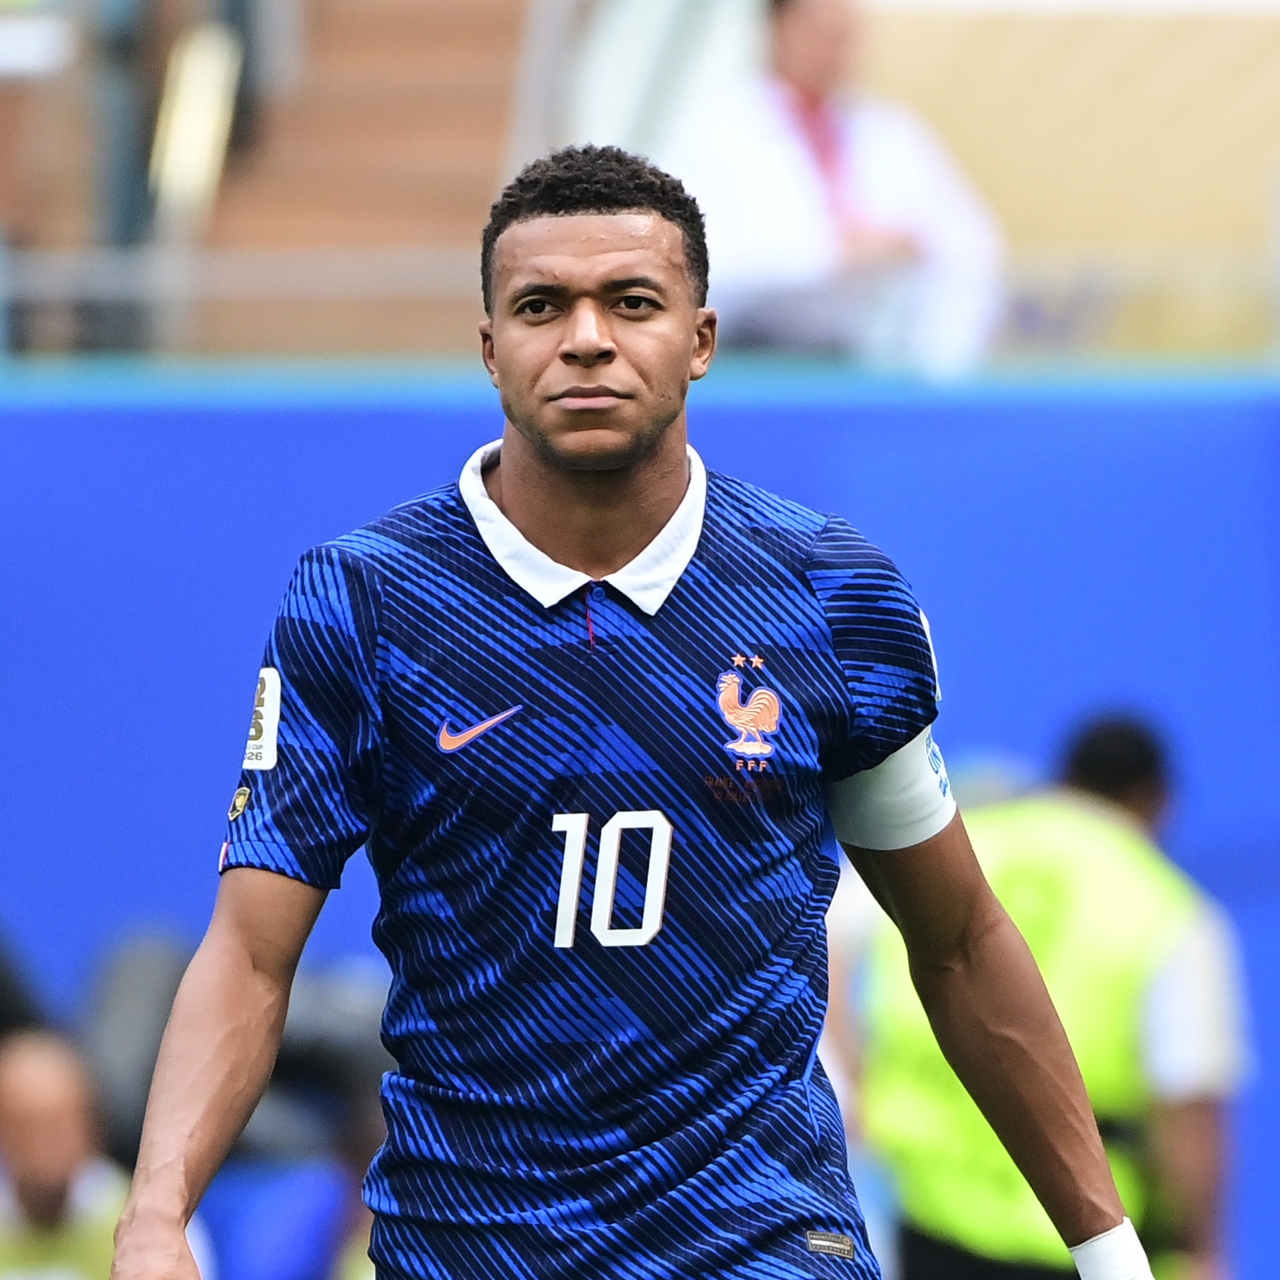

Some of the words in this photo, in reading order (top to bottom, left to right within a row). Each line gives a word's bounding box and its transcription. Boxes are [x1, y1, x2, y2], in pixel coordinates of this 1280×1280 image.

[245, 751, 263, 761] 26
[735, 760, 767, 772] FFF
[551, 810, 674, 948] 10
